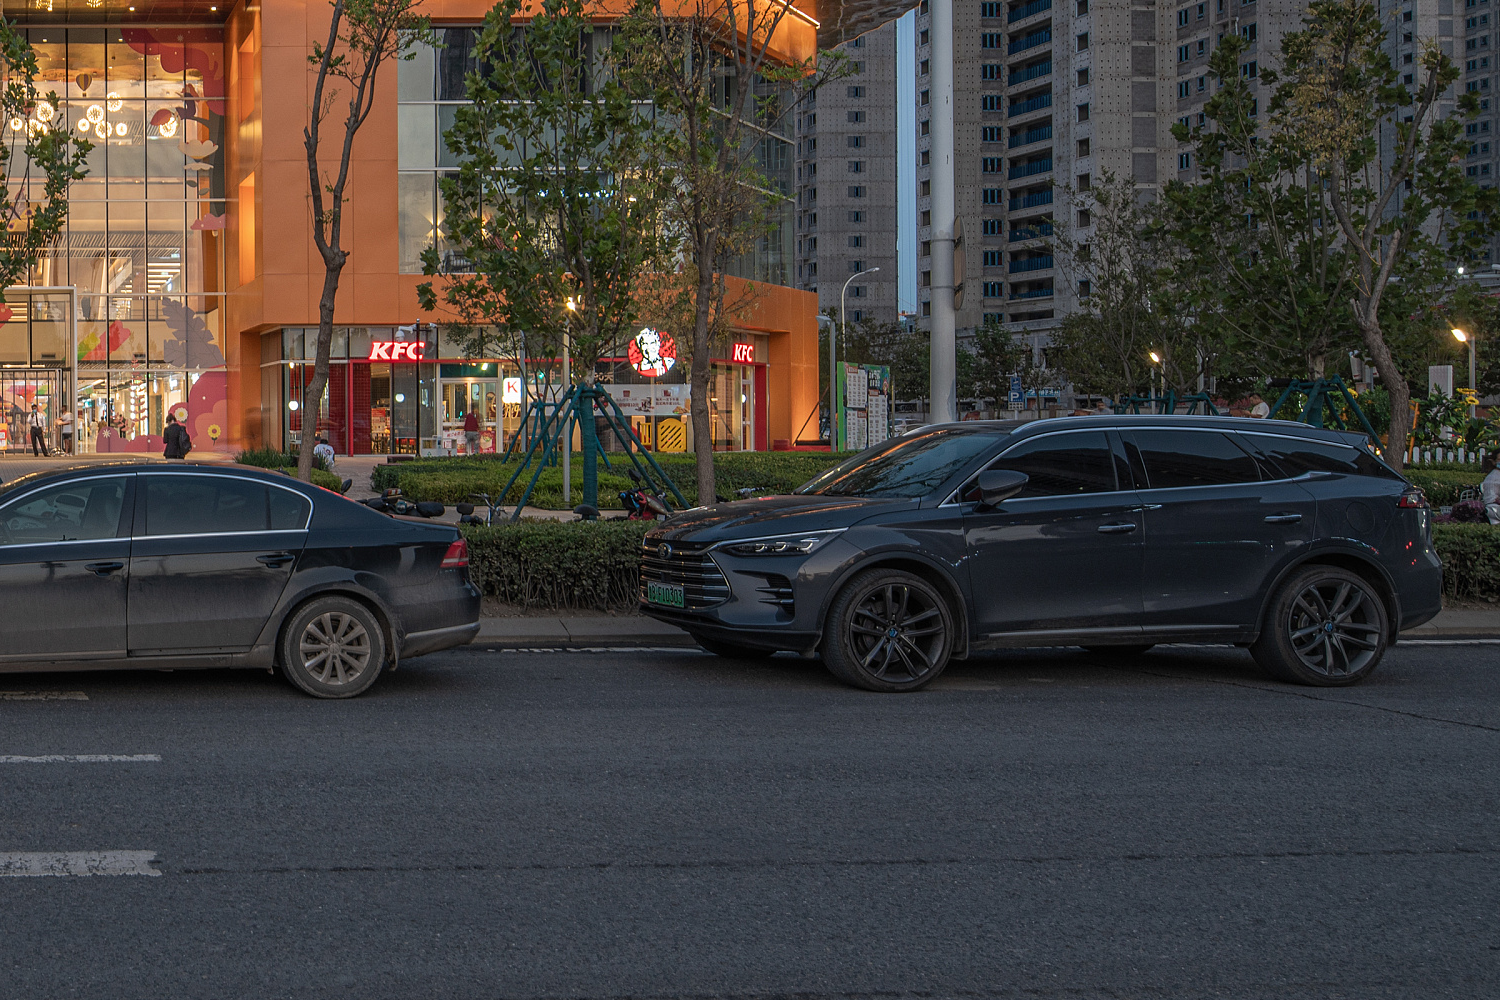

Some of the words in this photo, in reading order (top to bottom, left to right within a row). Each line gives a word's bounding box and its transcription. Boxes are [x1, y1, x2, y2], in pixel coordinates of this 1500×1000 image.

[369, 341, 425, 360] KFC
[733, 343, 754, 362] KFC
[507, 381, 518, 393] K
[1010, 392, 1020, 401] P
